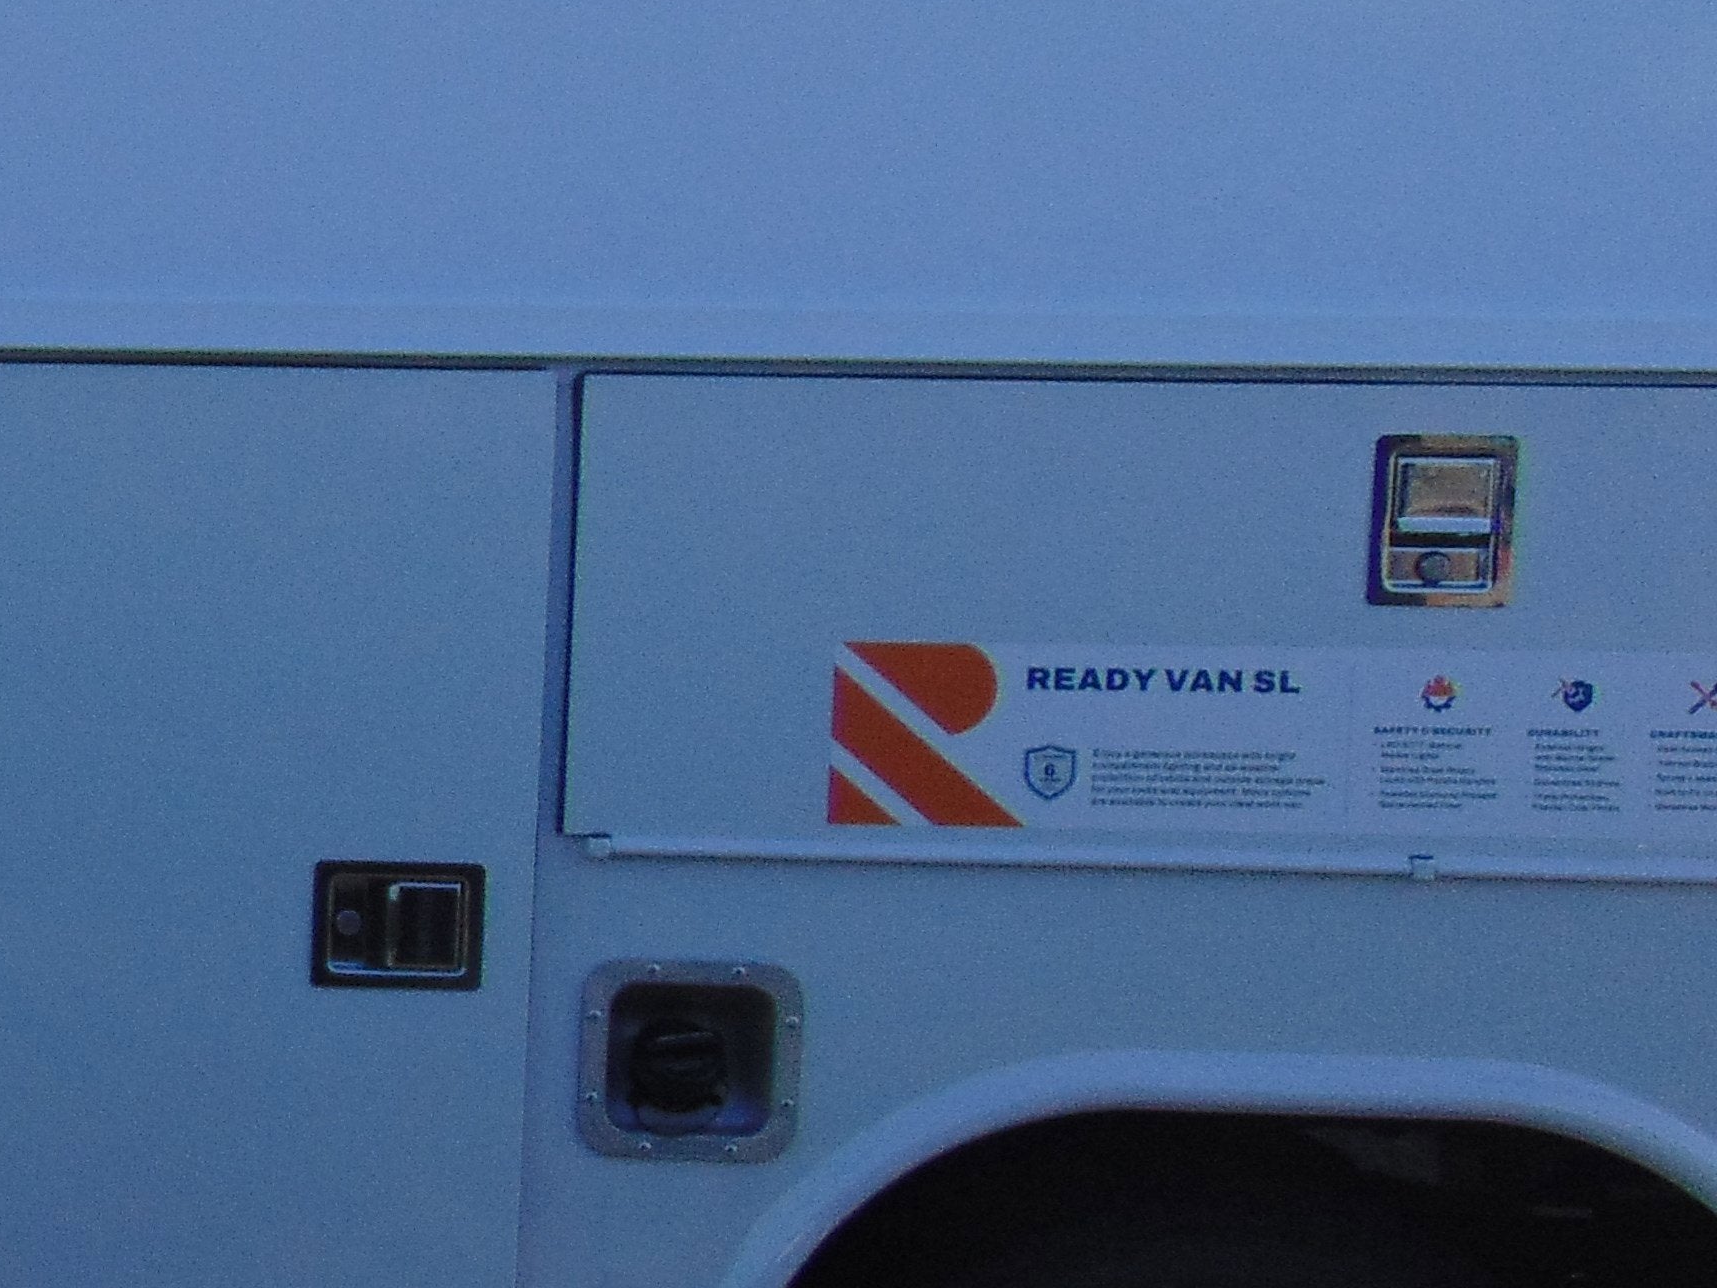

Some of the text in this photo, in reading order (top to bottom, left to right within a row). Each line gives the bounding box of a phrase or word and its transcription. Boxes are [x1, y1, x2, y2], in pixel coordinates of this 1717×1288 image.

[1025, 666, 1301, 695] READY VAN SL
